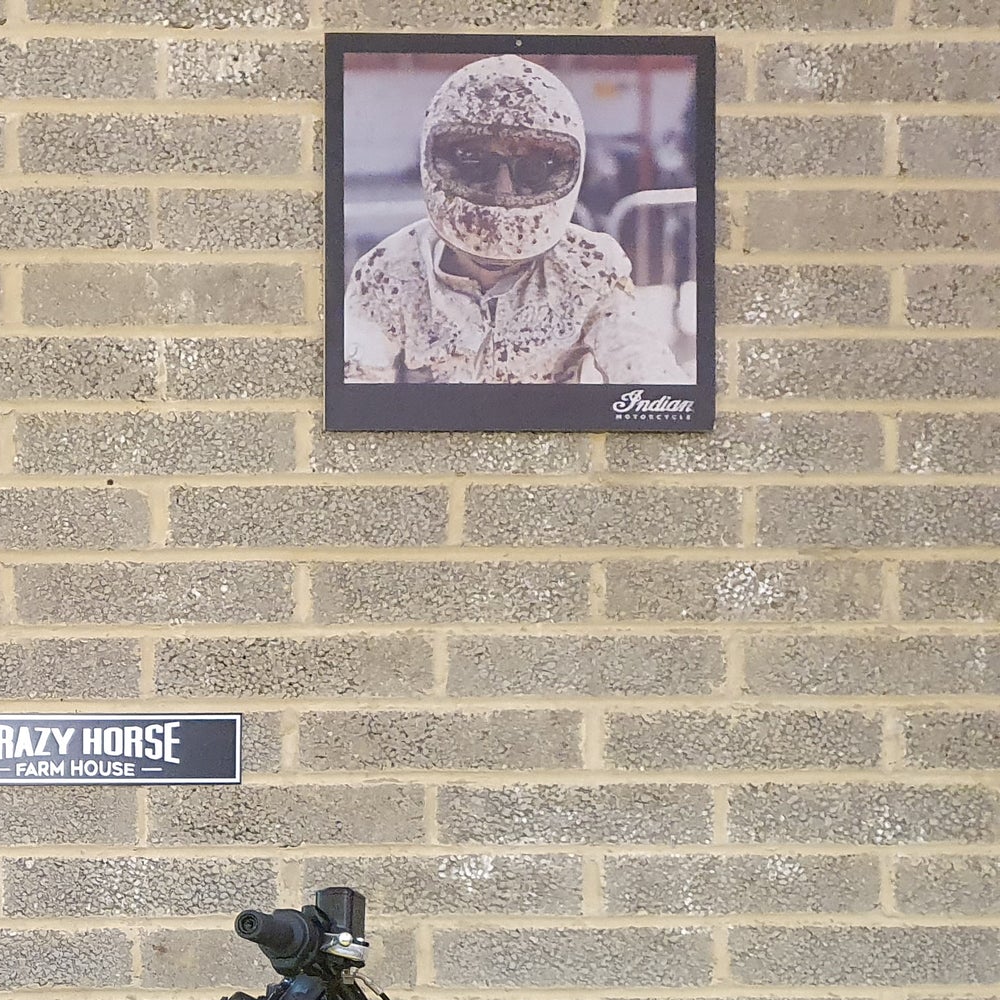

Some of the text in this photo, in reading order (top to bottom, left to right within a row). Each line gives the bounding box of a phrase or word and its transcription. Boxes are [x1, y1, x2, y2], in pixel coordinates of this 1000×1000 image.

[612, 389, 695, 413] Indian
[82, 721, 181, 764] HORSE
[15, 759, 136, 777] FARM HOUSE
